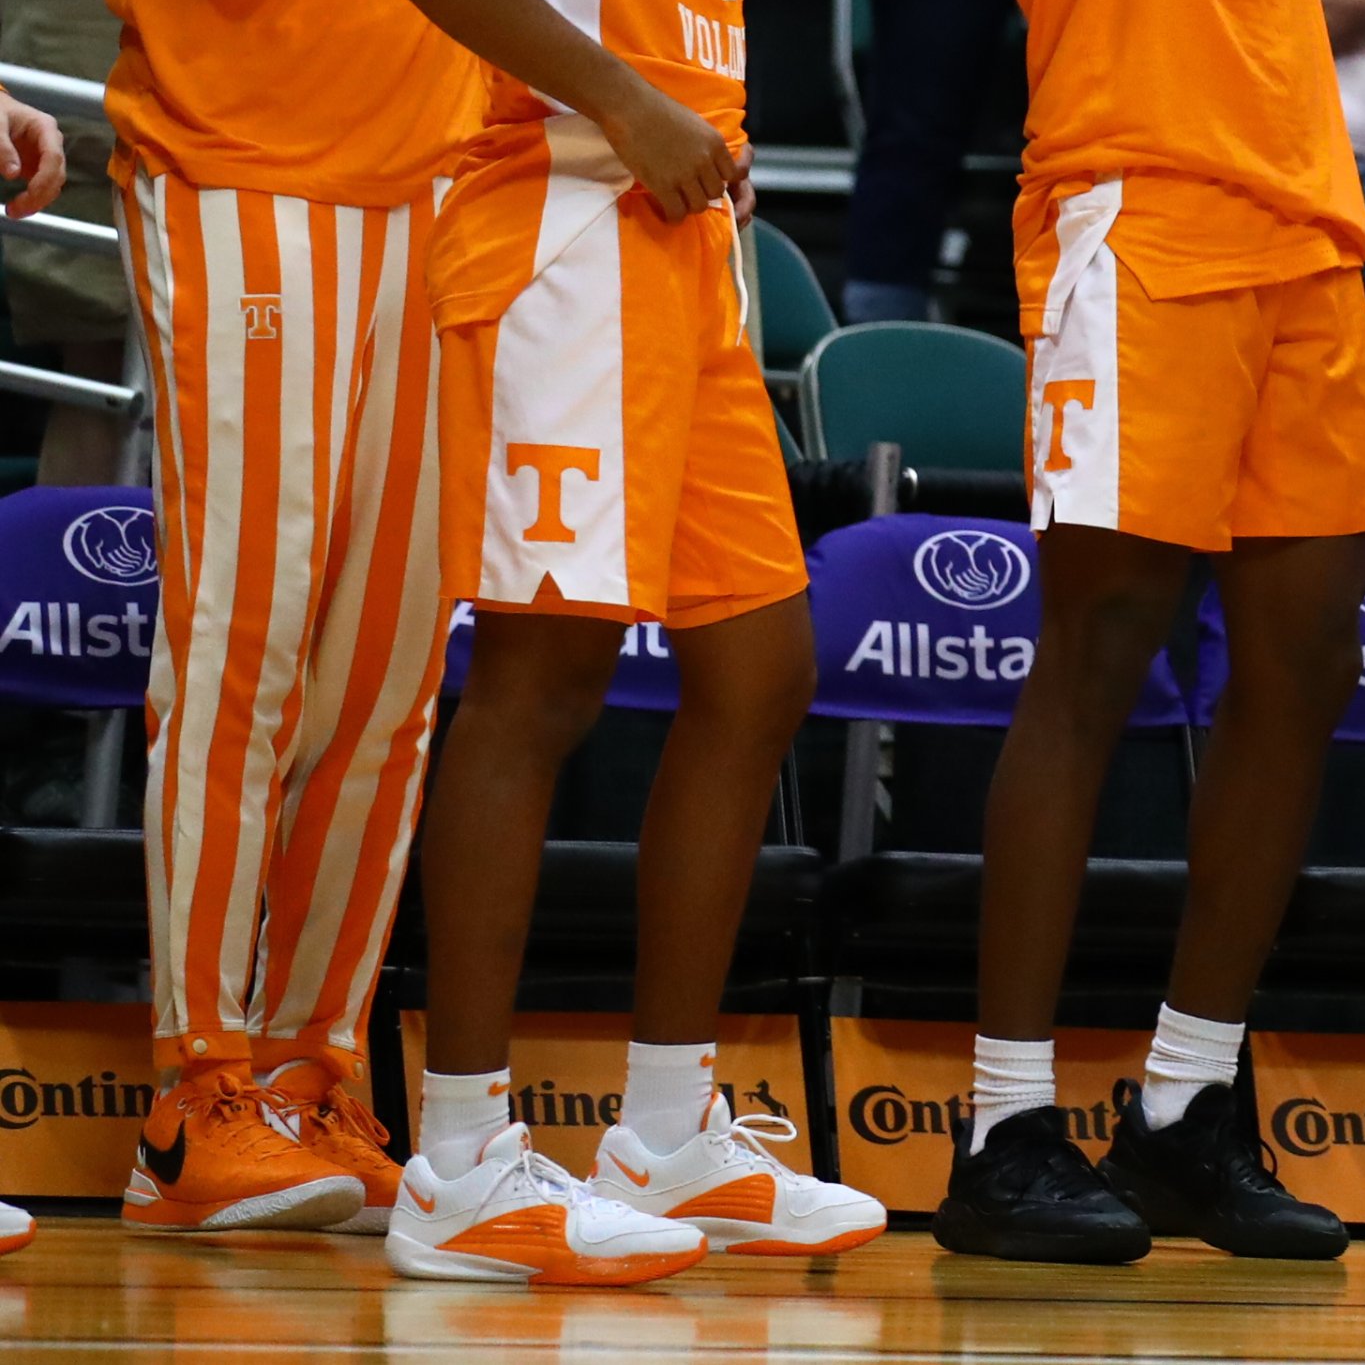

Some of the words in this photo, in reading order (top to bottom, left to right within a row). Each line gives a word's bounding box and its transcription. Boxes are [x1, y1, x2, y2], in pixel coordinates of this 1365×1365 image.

[238, 294, 284, 339] T
[1041, 380, 1096, 473] T
[506, 443, 600, 543] T
[0, 601, 150, 658] Allst
[844, 620, 1039, 681] Allsta
